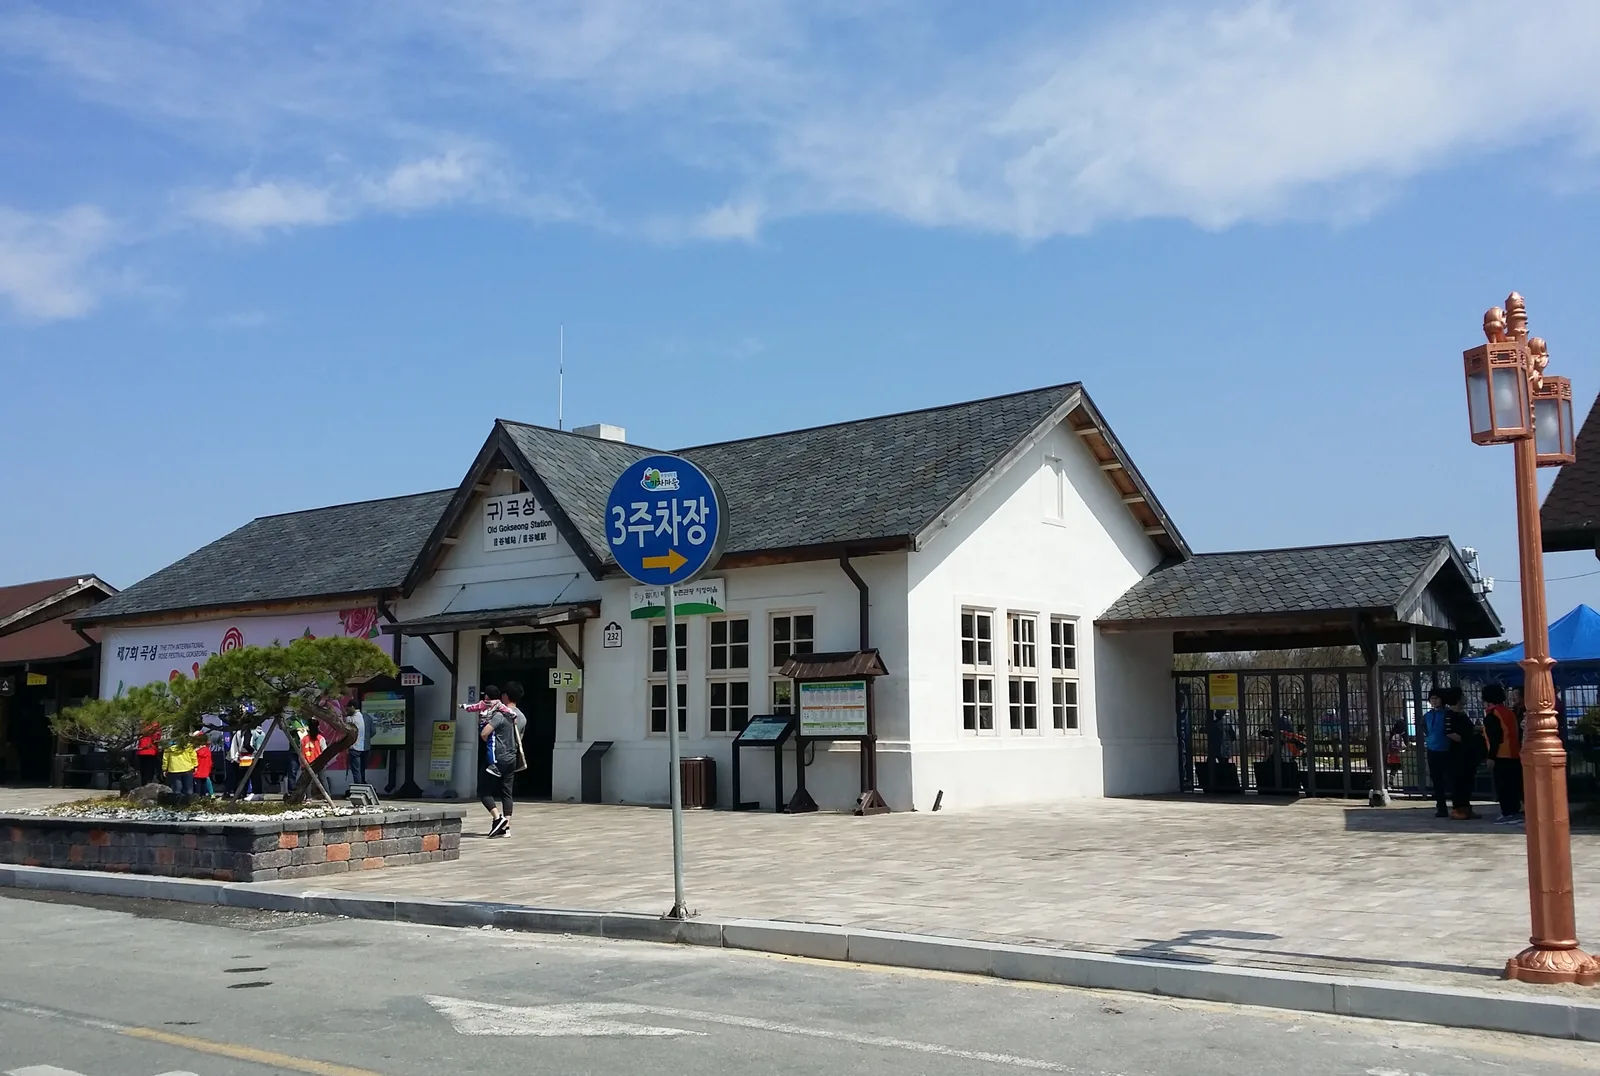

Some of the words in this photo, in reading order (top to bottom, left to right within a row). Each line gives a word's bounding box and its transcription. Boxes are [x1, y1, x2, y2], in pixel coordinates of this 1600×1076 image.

[487, 497, 544, 520] 구)곡성
[487, 526, 498, 534] Old
[499, 522, 529, 533] Gokseong
[530, 520, 553, 529] Station
[612, 496, 710, 548] 3주차장
[607, 632, 619, 641] 232
[117, 646, 139, 661] 제7회
[140, 644, 158, 661] 곡성
[552, 672, 573, 685] 입구
